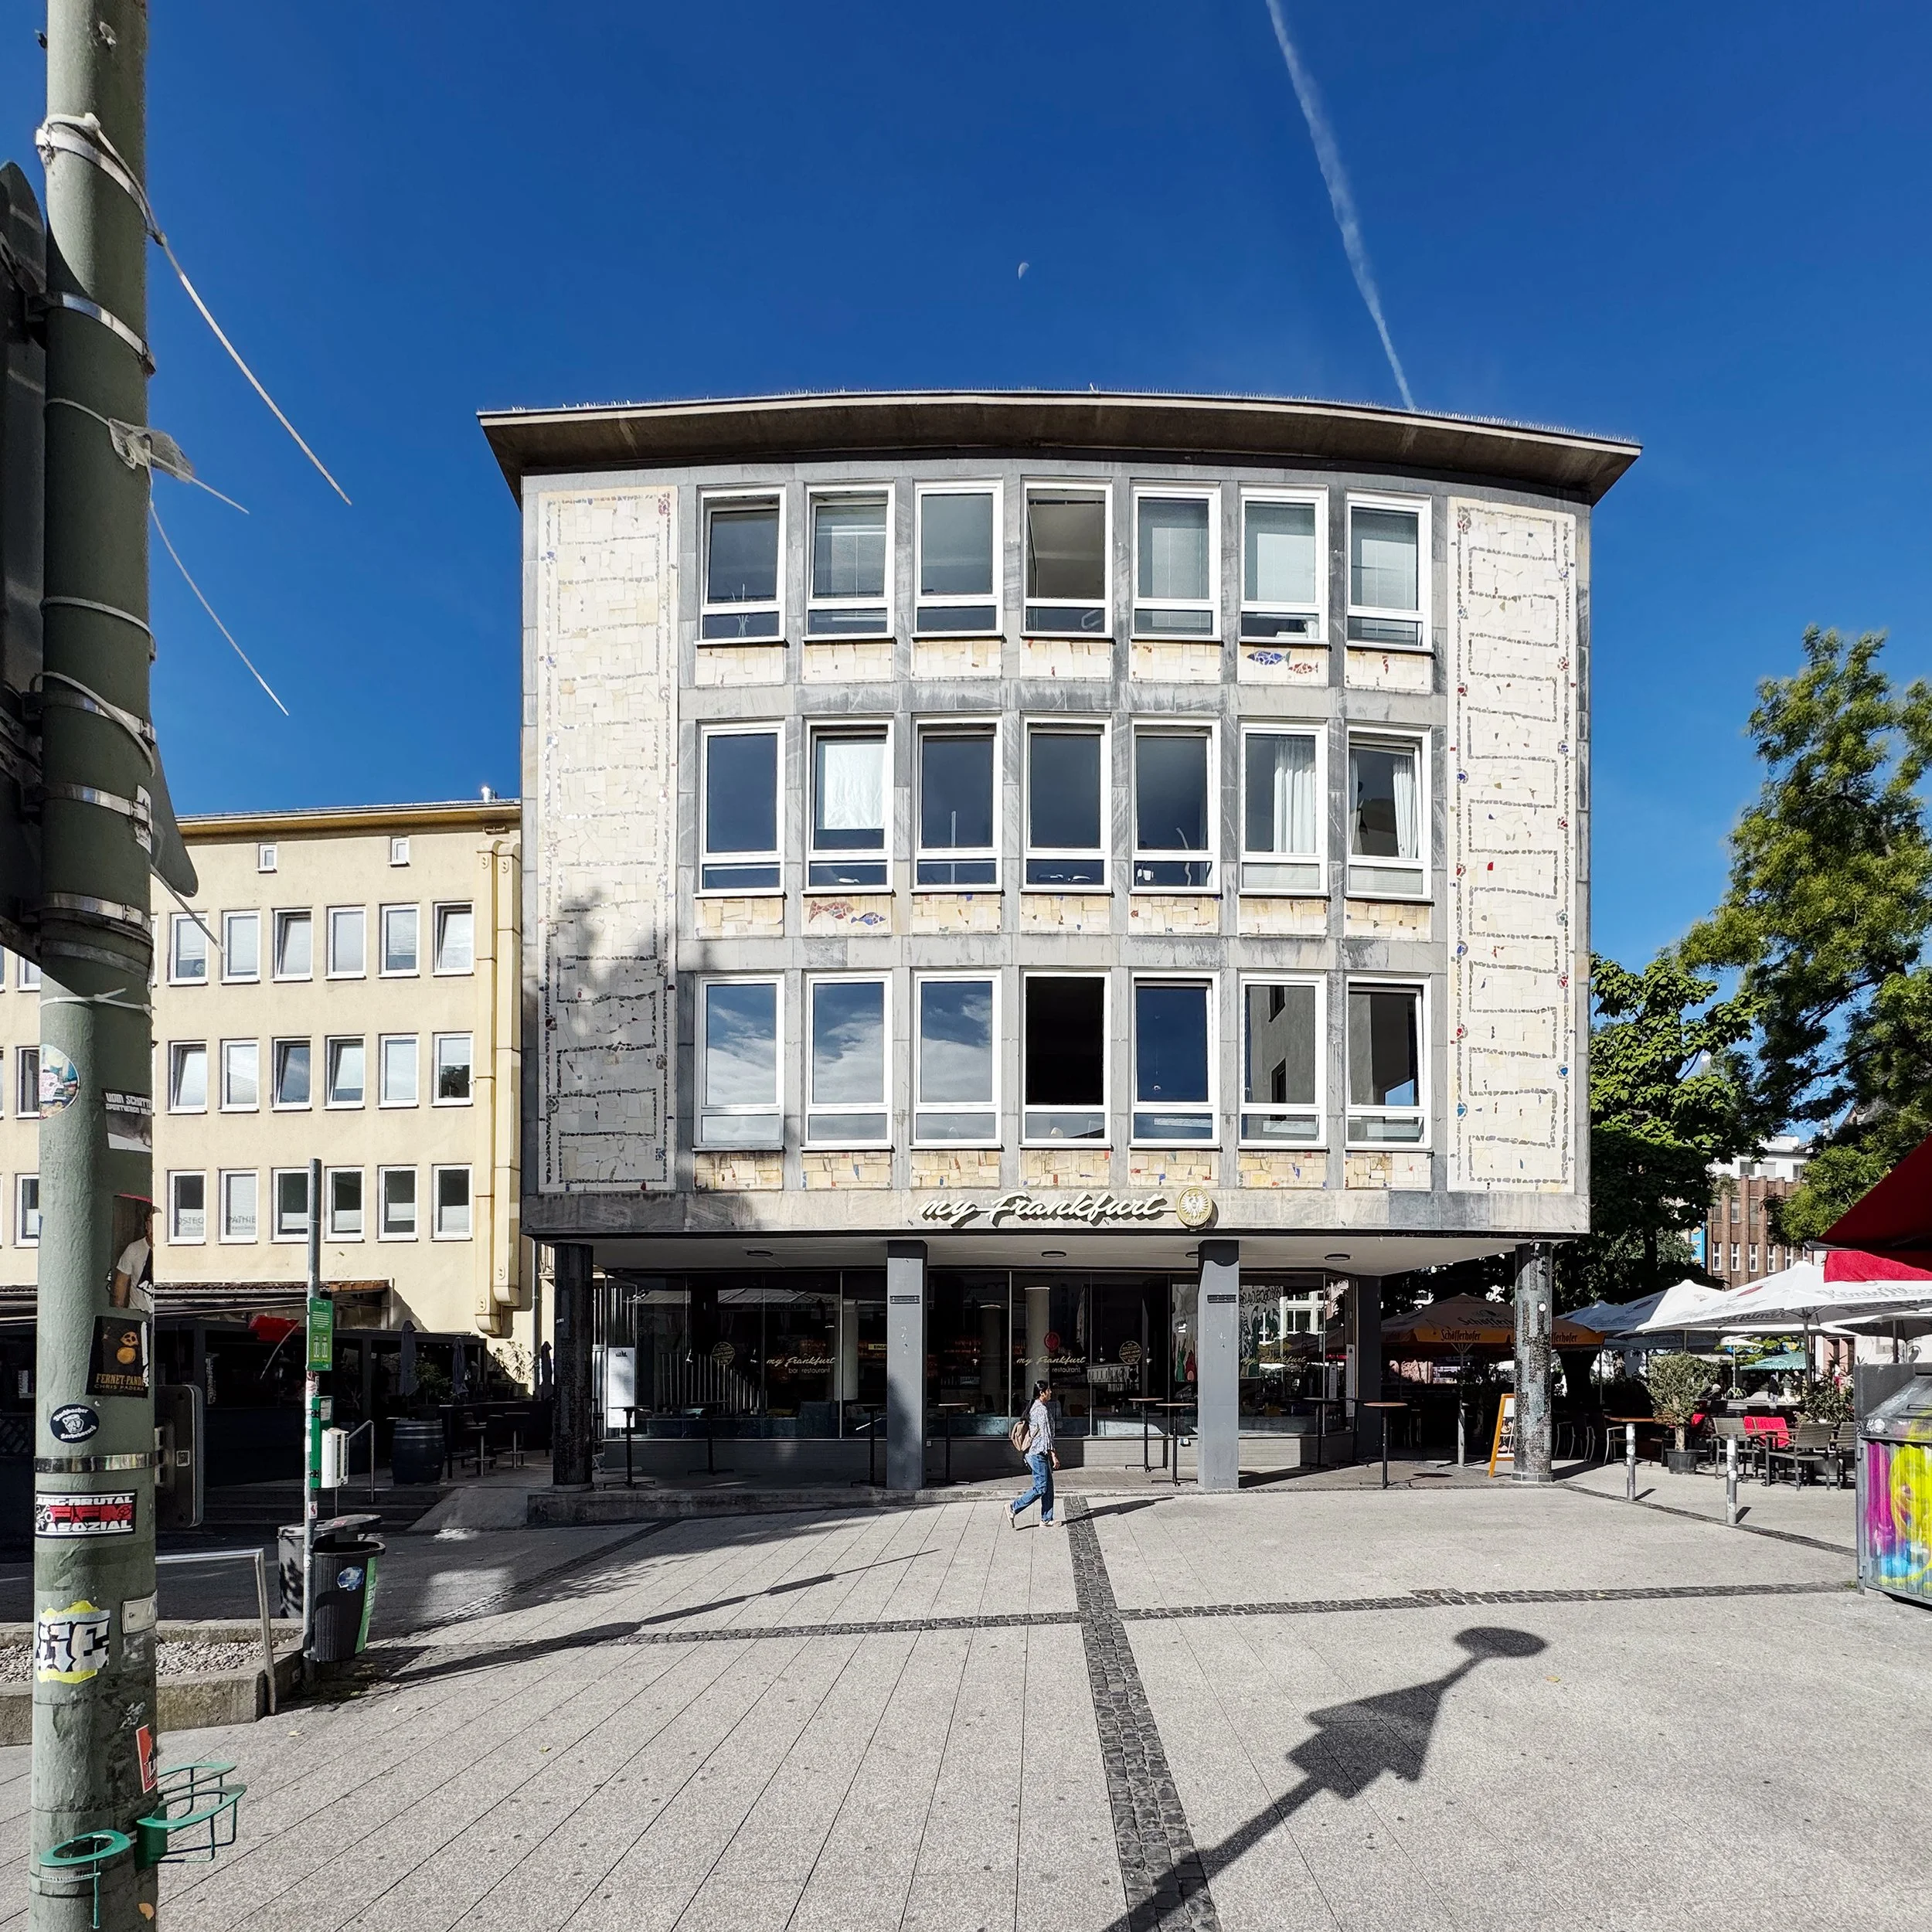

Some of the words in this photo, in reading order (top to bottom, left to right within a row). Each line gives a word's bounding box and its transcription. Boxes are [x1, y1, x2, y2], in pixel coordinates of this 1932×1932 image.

[918, 1199, 976, 1225] my
[986, 1191, 1164, 1223] Frankfurt
[1440, 1329, 1481, 1342] Schöfferhofer
[1551, 1332, 1578, 1343] fferhofer
[766, 1359, 783, 1367] my
[784, 1356, 835, 1367] Frankfurt
[1016, 1358, 1032, 1366] my
[1036, 1355, 1086, 1366] Frankfurt
[46, 1520, 131, 1532] ASOZIAL
